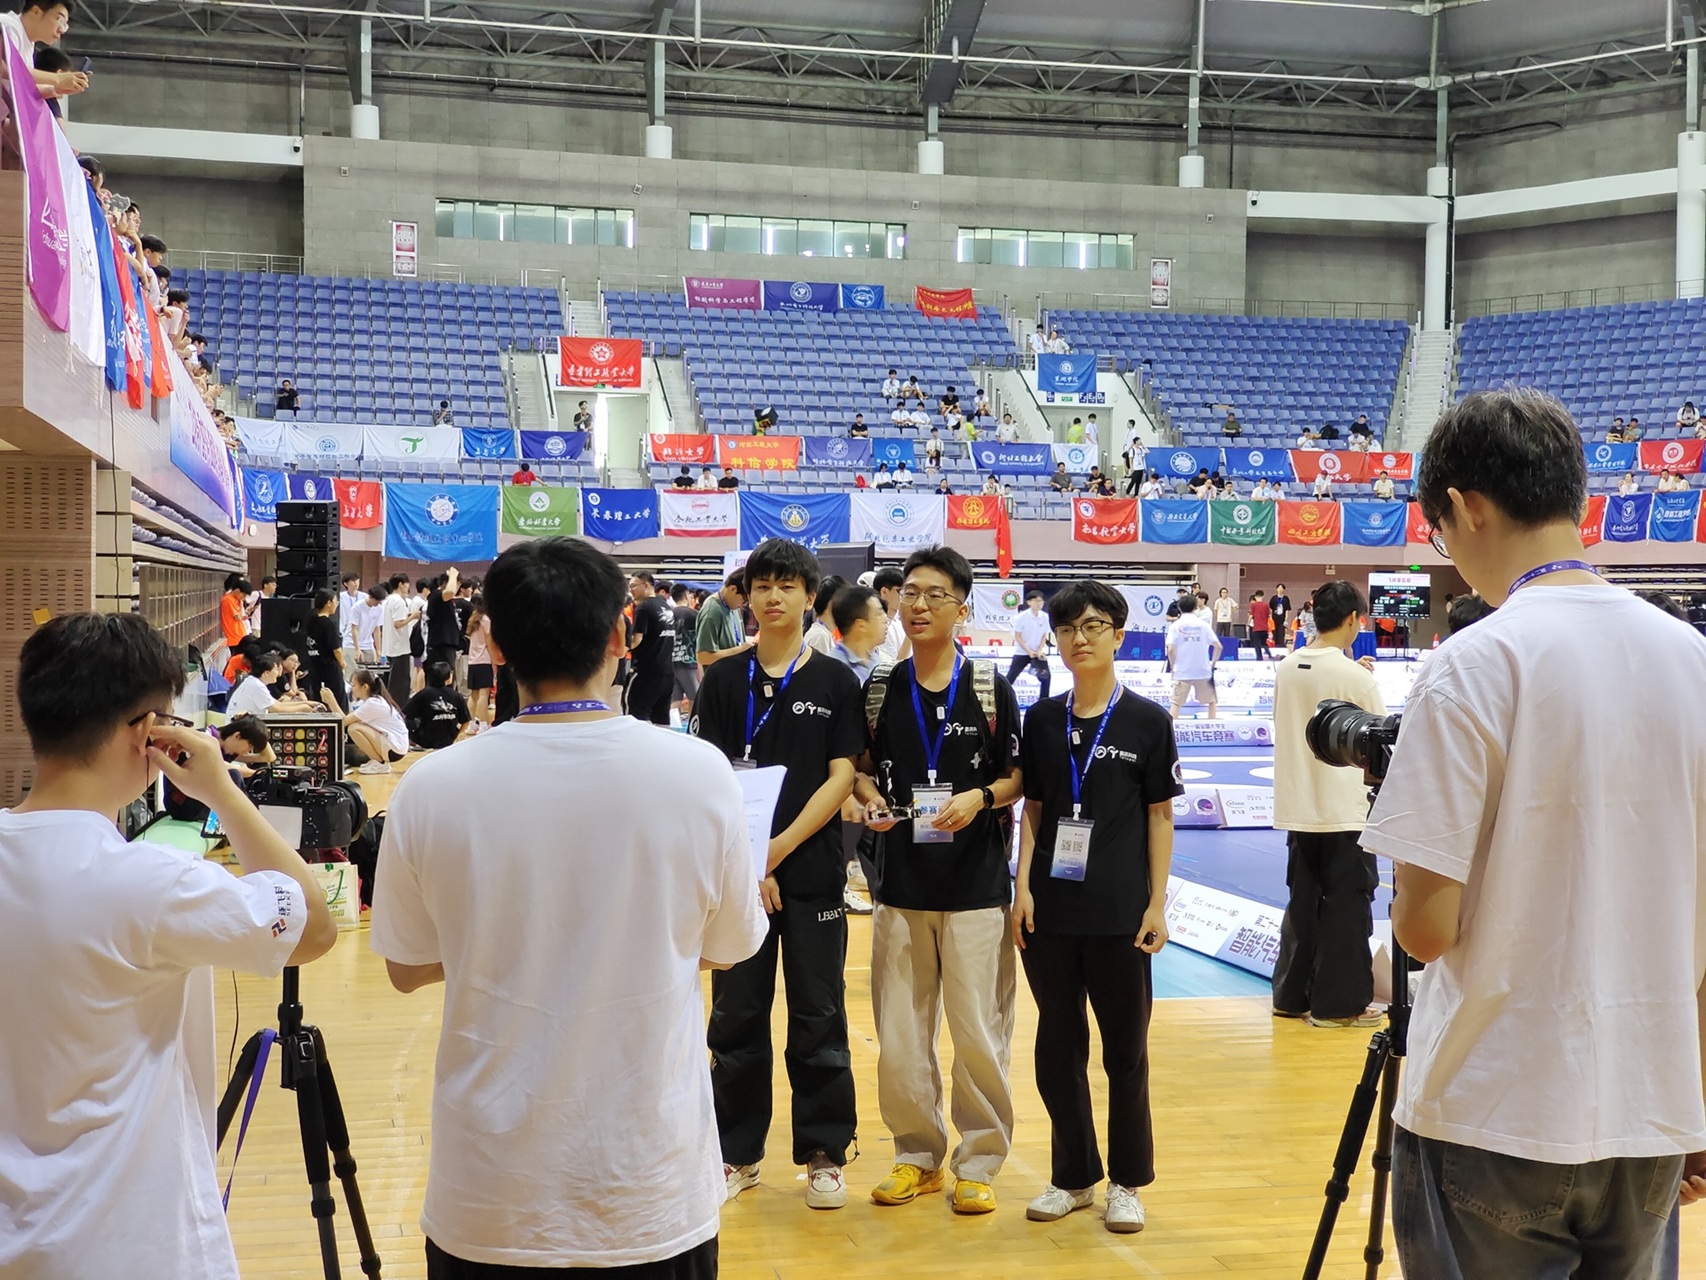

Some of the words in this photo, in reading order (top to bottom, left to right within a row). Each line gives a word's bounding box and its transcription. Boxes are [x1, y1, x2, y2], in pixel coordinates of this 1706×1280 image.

[730, 458, 796, 469] 科信学院
[591, 507, 651, 520] 长春理工大学
[674, 514, 728, 524] 合肥工业大学
[1081, 522, 1136, 537] 南昌航空大学
[864, 531, 933, 543] 湖北汽车工业学院
[920, 805, 940, 815] 参赛
